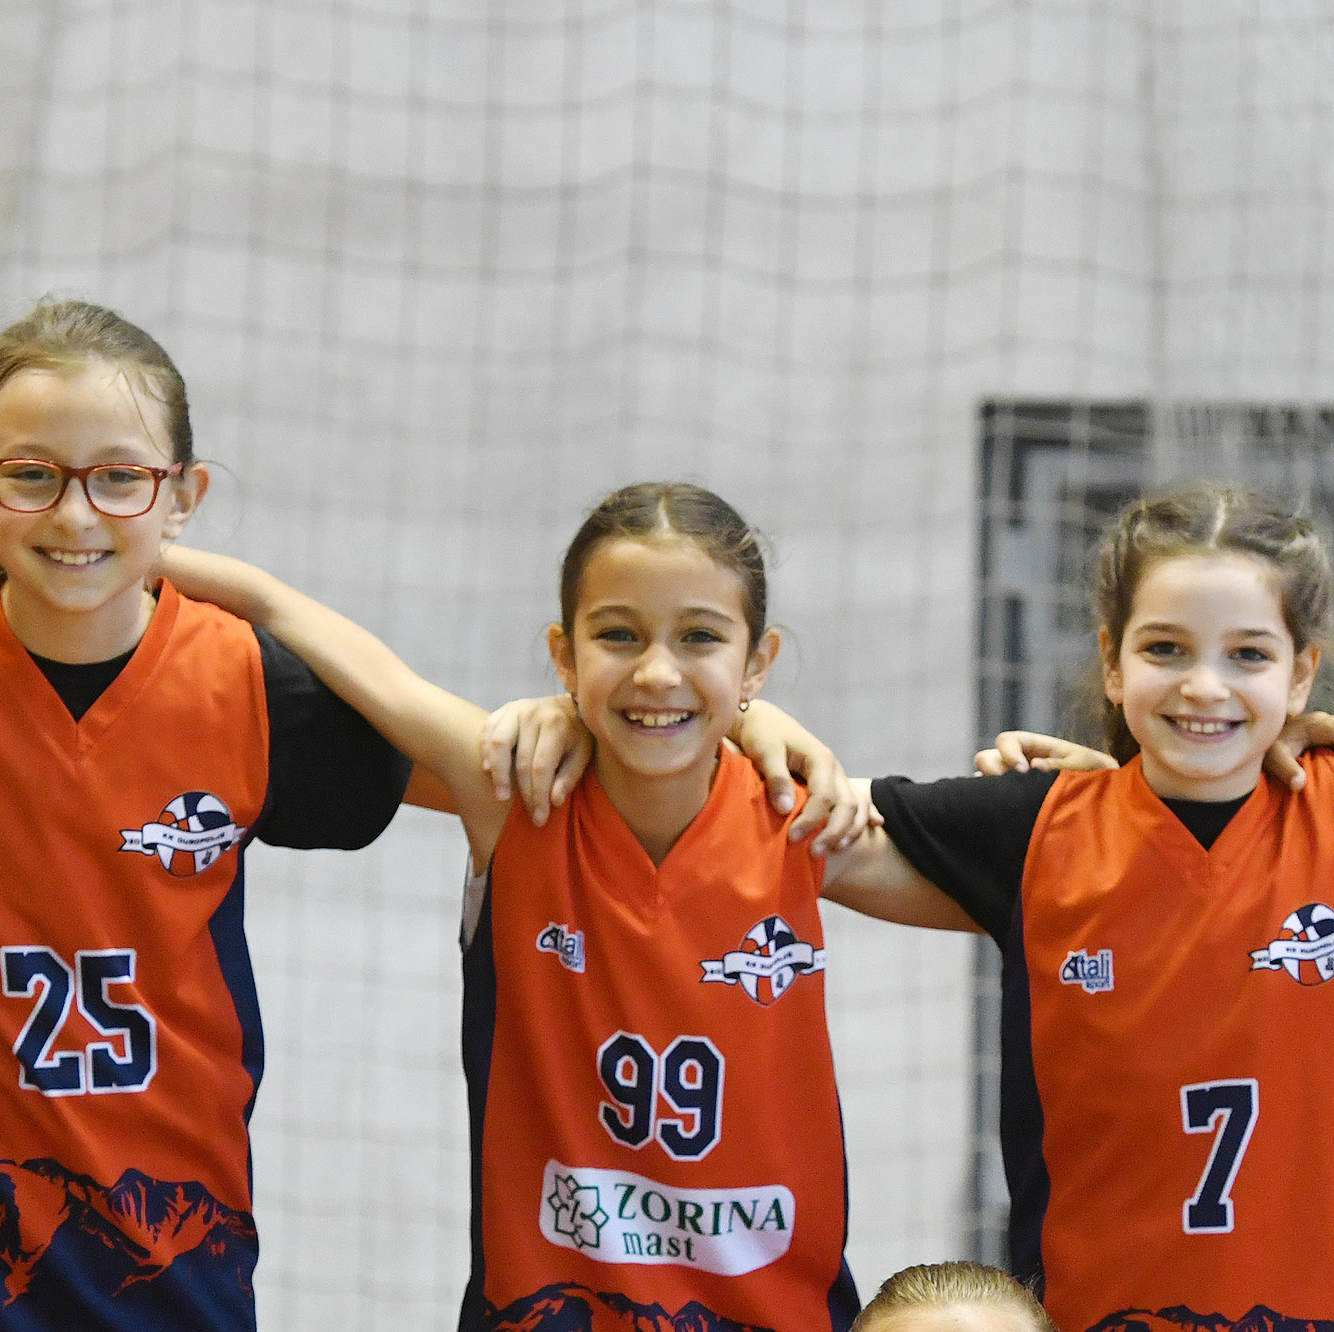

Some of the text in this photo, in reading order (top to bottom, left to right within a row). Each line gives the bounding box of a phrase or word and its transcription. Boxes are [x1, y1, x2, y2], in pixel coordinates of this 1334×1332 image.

[1063, 953, 1110, 981] Atali
[596, 1029, 725, 1162] 99
[1179, 1077, 1260, 1235] 7
[613, 1182, 788, 1237] ZORINA
[624, 1230, 696, 1263] mast
